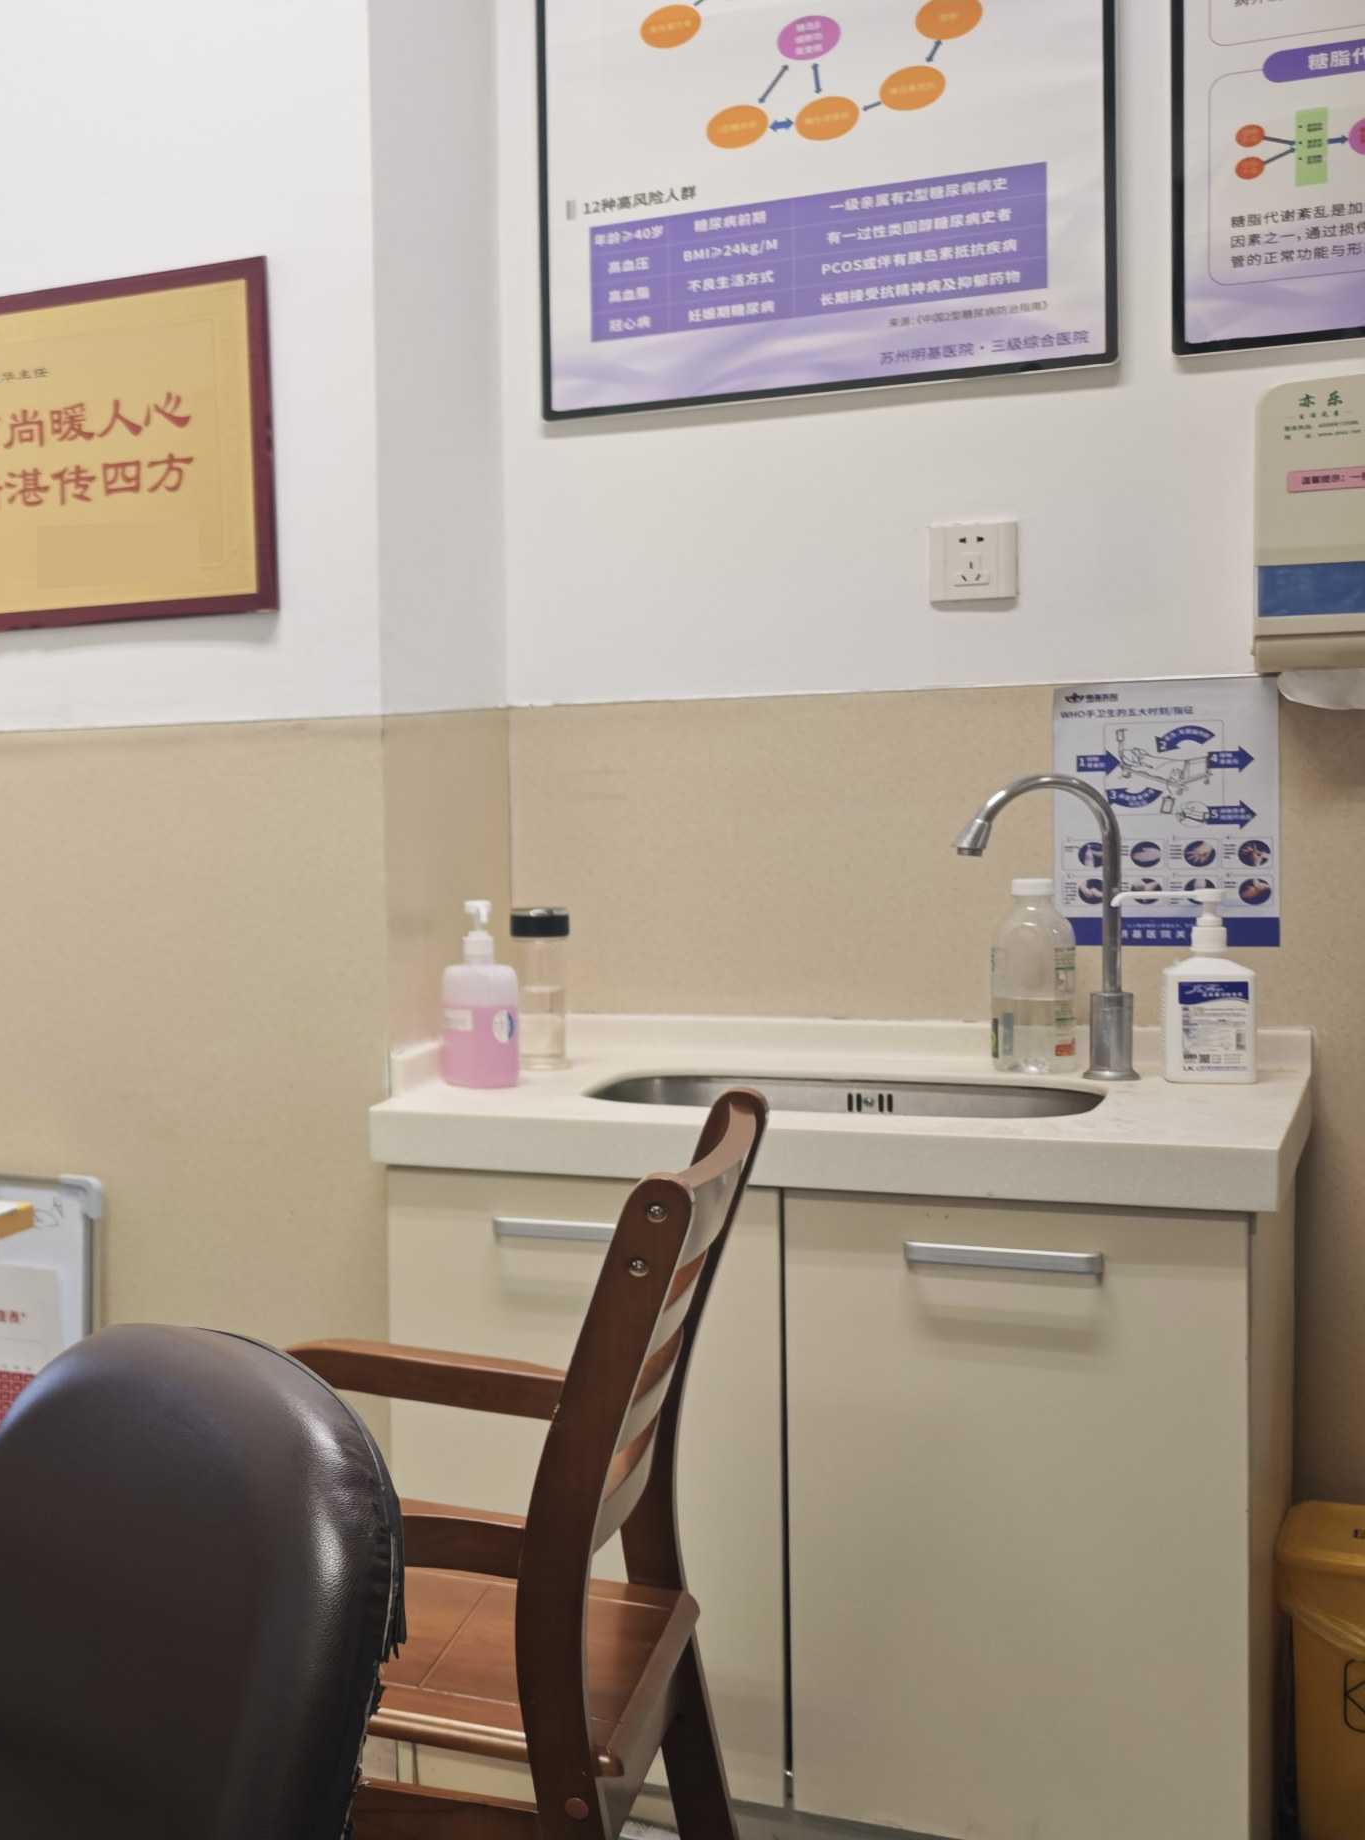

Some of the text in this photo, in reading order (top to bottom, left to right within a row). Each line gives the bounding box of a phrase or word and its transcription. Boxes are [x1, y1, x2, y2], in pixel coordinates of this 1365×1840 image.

[583, 185, 697, 215] 12种高风险人群
[1231, 202, 1365, 228] 糖脂代谢紊乱是加
[1231, 243, 1365, 268] 管的正常功能与形
[687, 270, 775, 293] 不良生活方式
